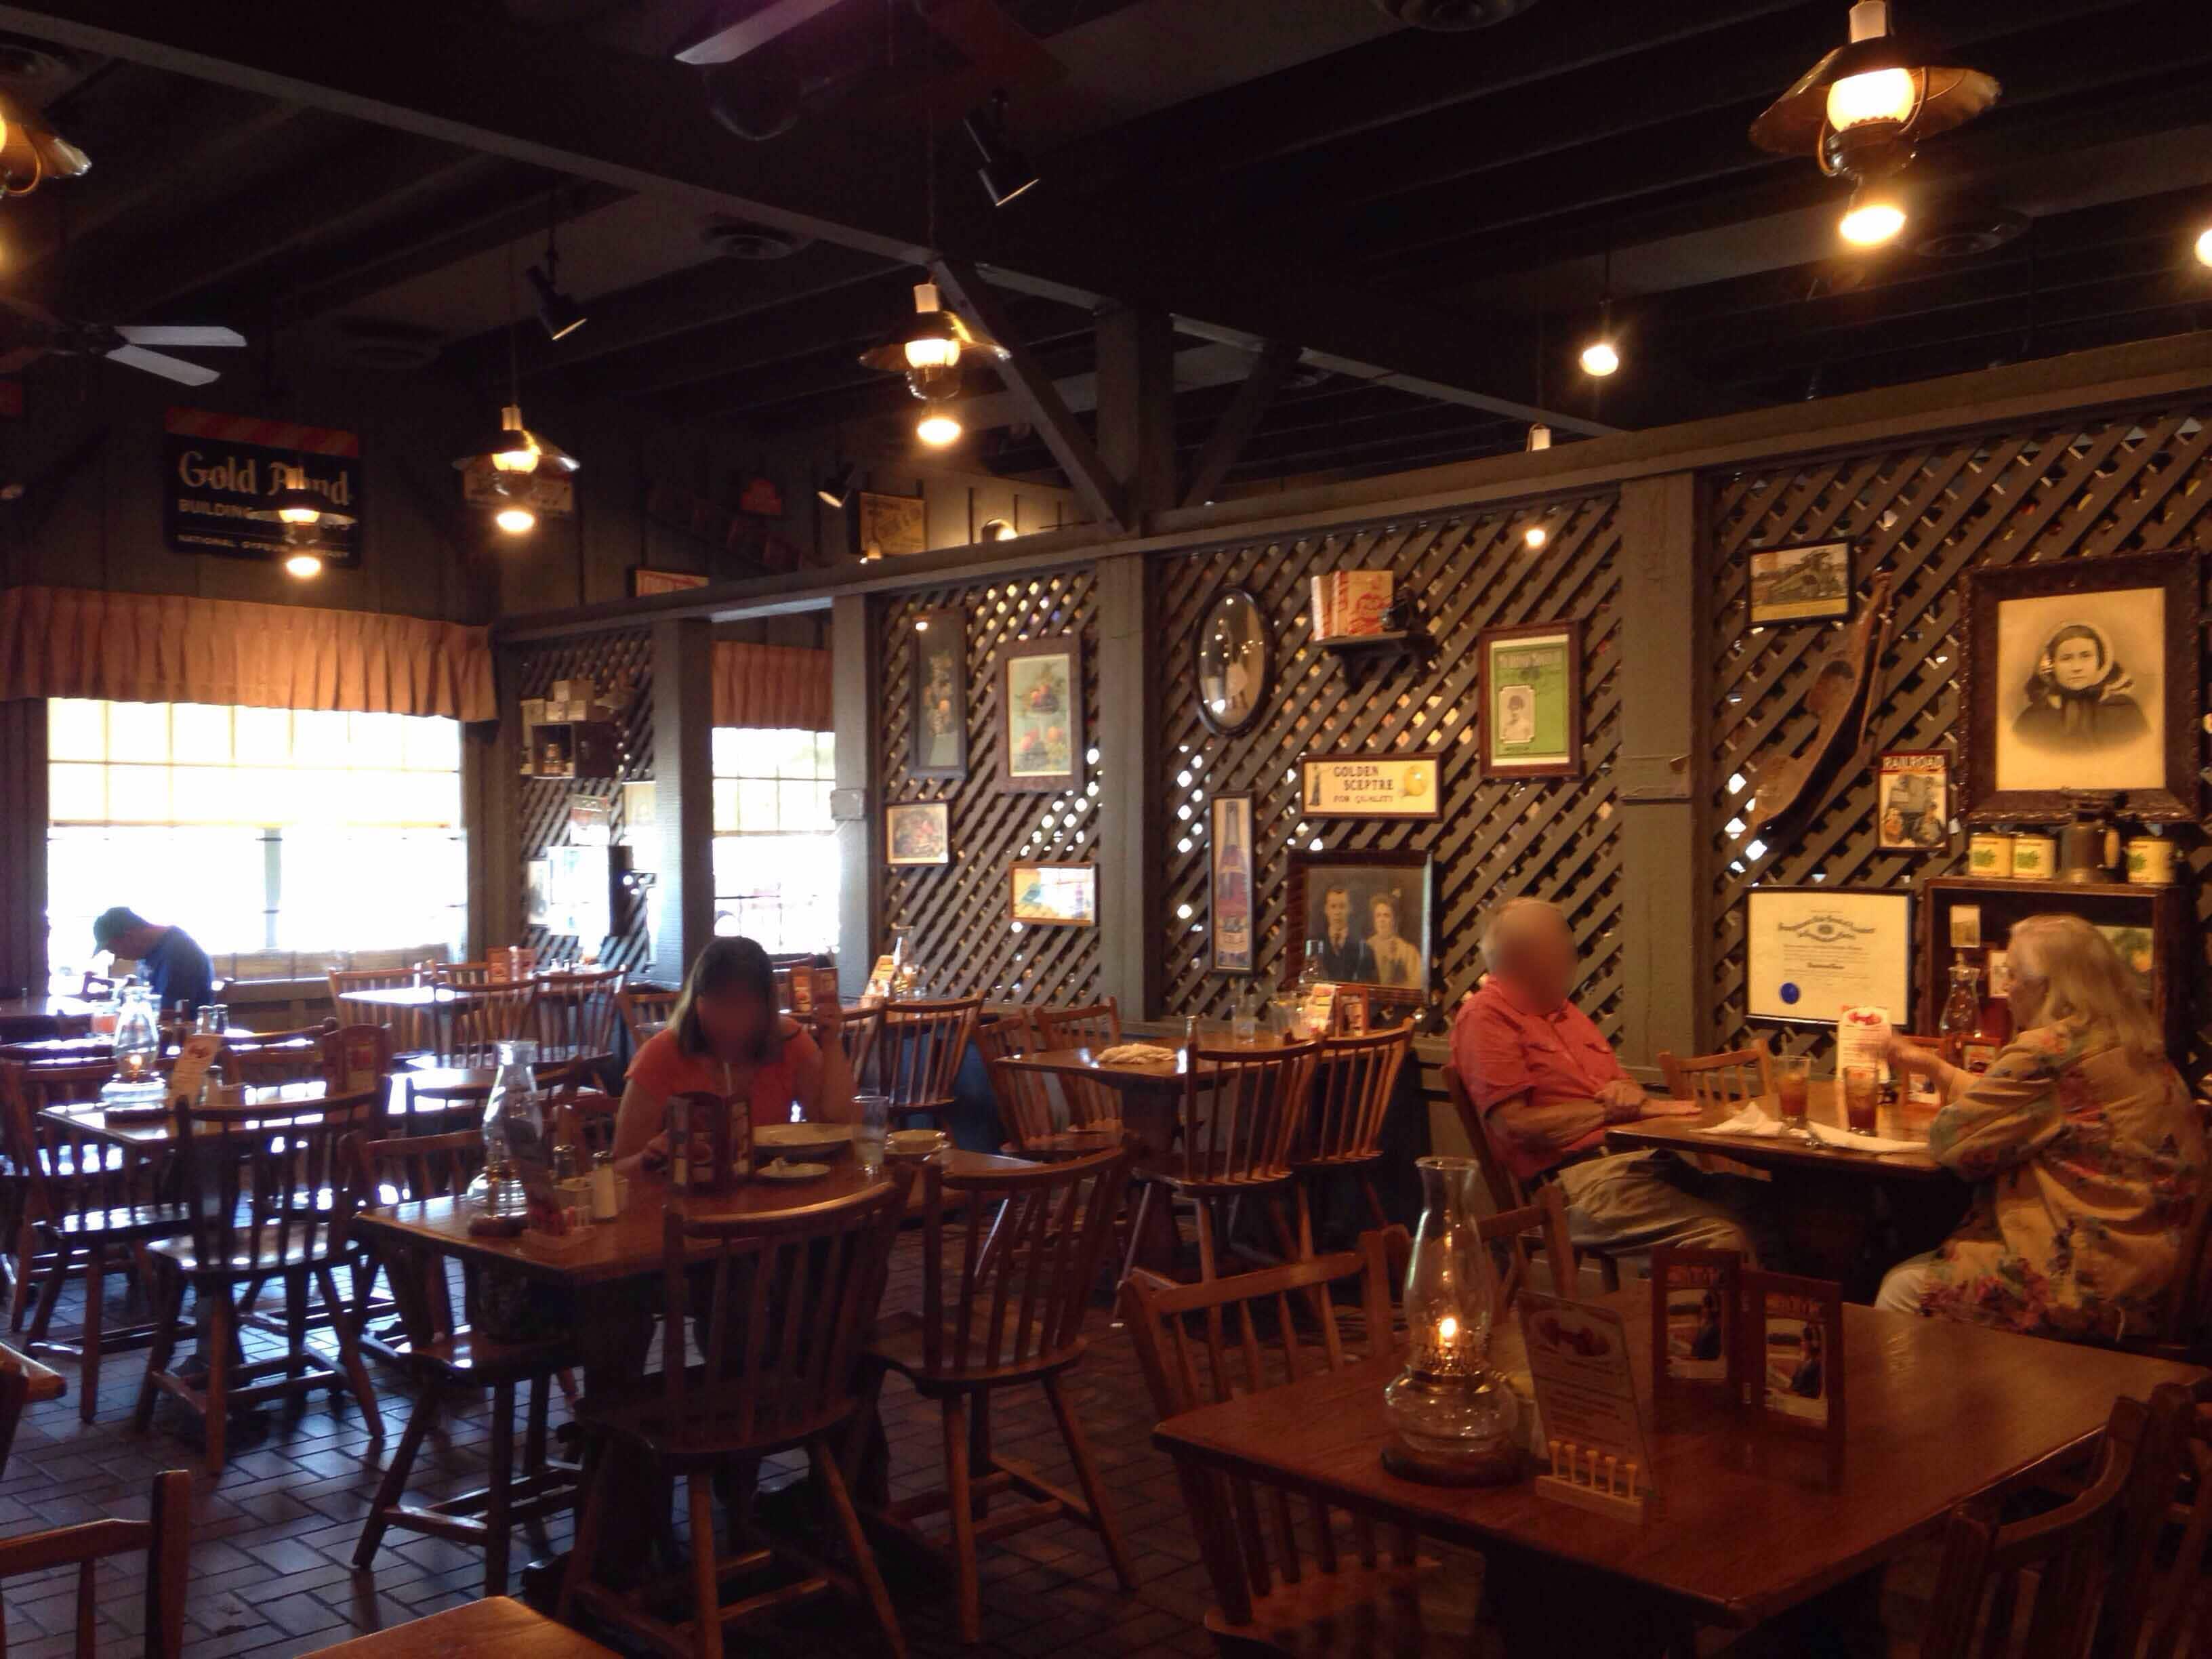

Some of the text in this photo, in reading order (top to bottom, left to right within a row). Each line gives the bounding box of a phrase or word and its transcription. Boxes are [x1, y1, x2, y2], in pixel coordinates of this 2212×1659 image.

[178, 450, 349, 506] Gold Bnd
[1333, 766, 1378, 777] GOLDEN
[1344, 779, 1393, 791] SCEPTRE
[1333, 795, 1350, 803] FOR
